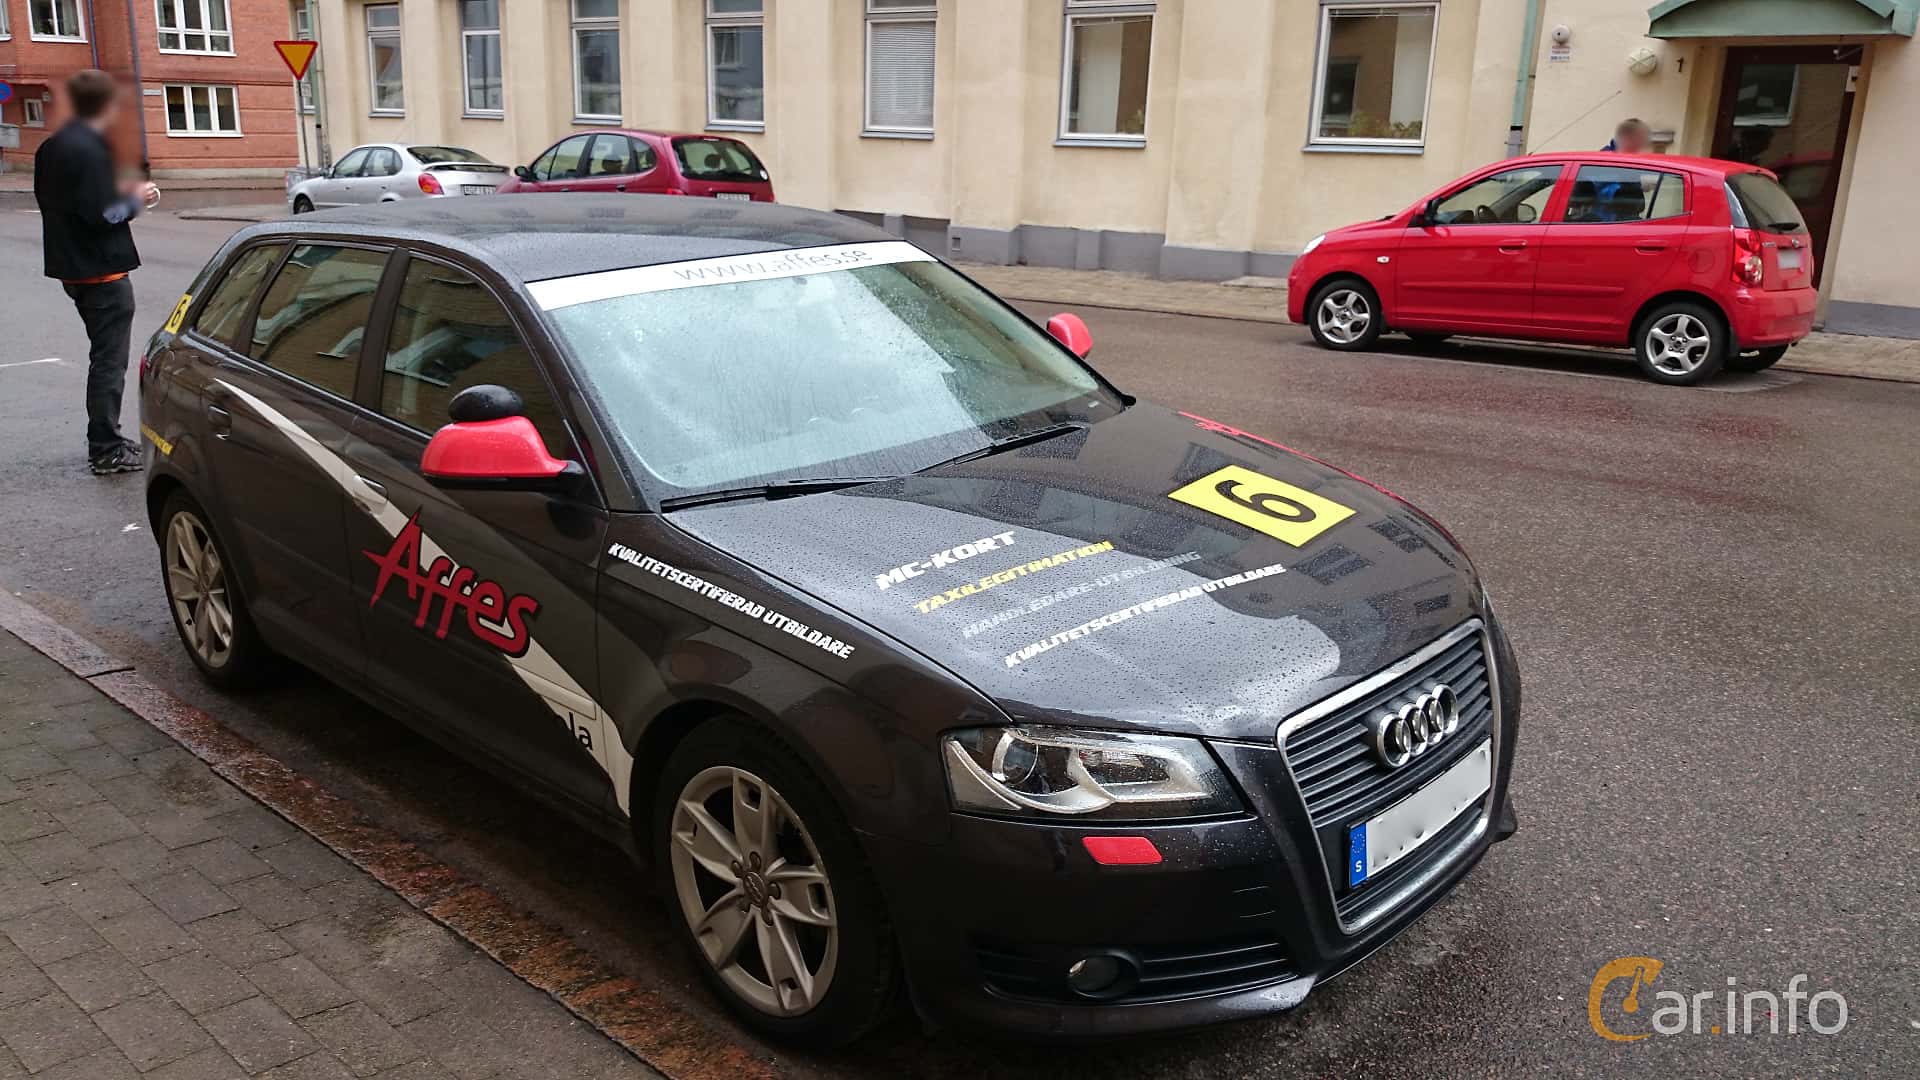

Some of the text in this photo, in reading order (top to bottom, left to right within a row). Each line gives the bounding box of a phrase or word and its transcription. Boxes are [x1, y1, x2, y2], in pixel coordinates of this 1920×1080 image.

[674, 250, 872, 281] www.affes.se
[363, 509, 540, 658] Affes
[874, 530, 1017, 591] MC-KORT
[913, 540, 1115, 614] TAXILEGITIMATION
[608, 542, 855, 660] KVALITETSCERTIFIERAD UTBILDARE
[1004, 563, 1288, 668] KVALITETSCERTIFIERAD UTBILDARE
[1355, 860, 1362, 872] S
